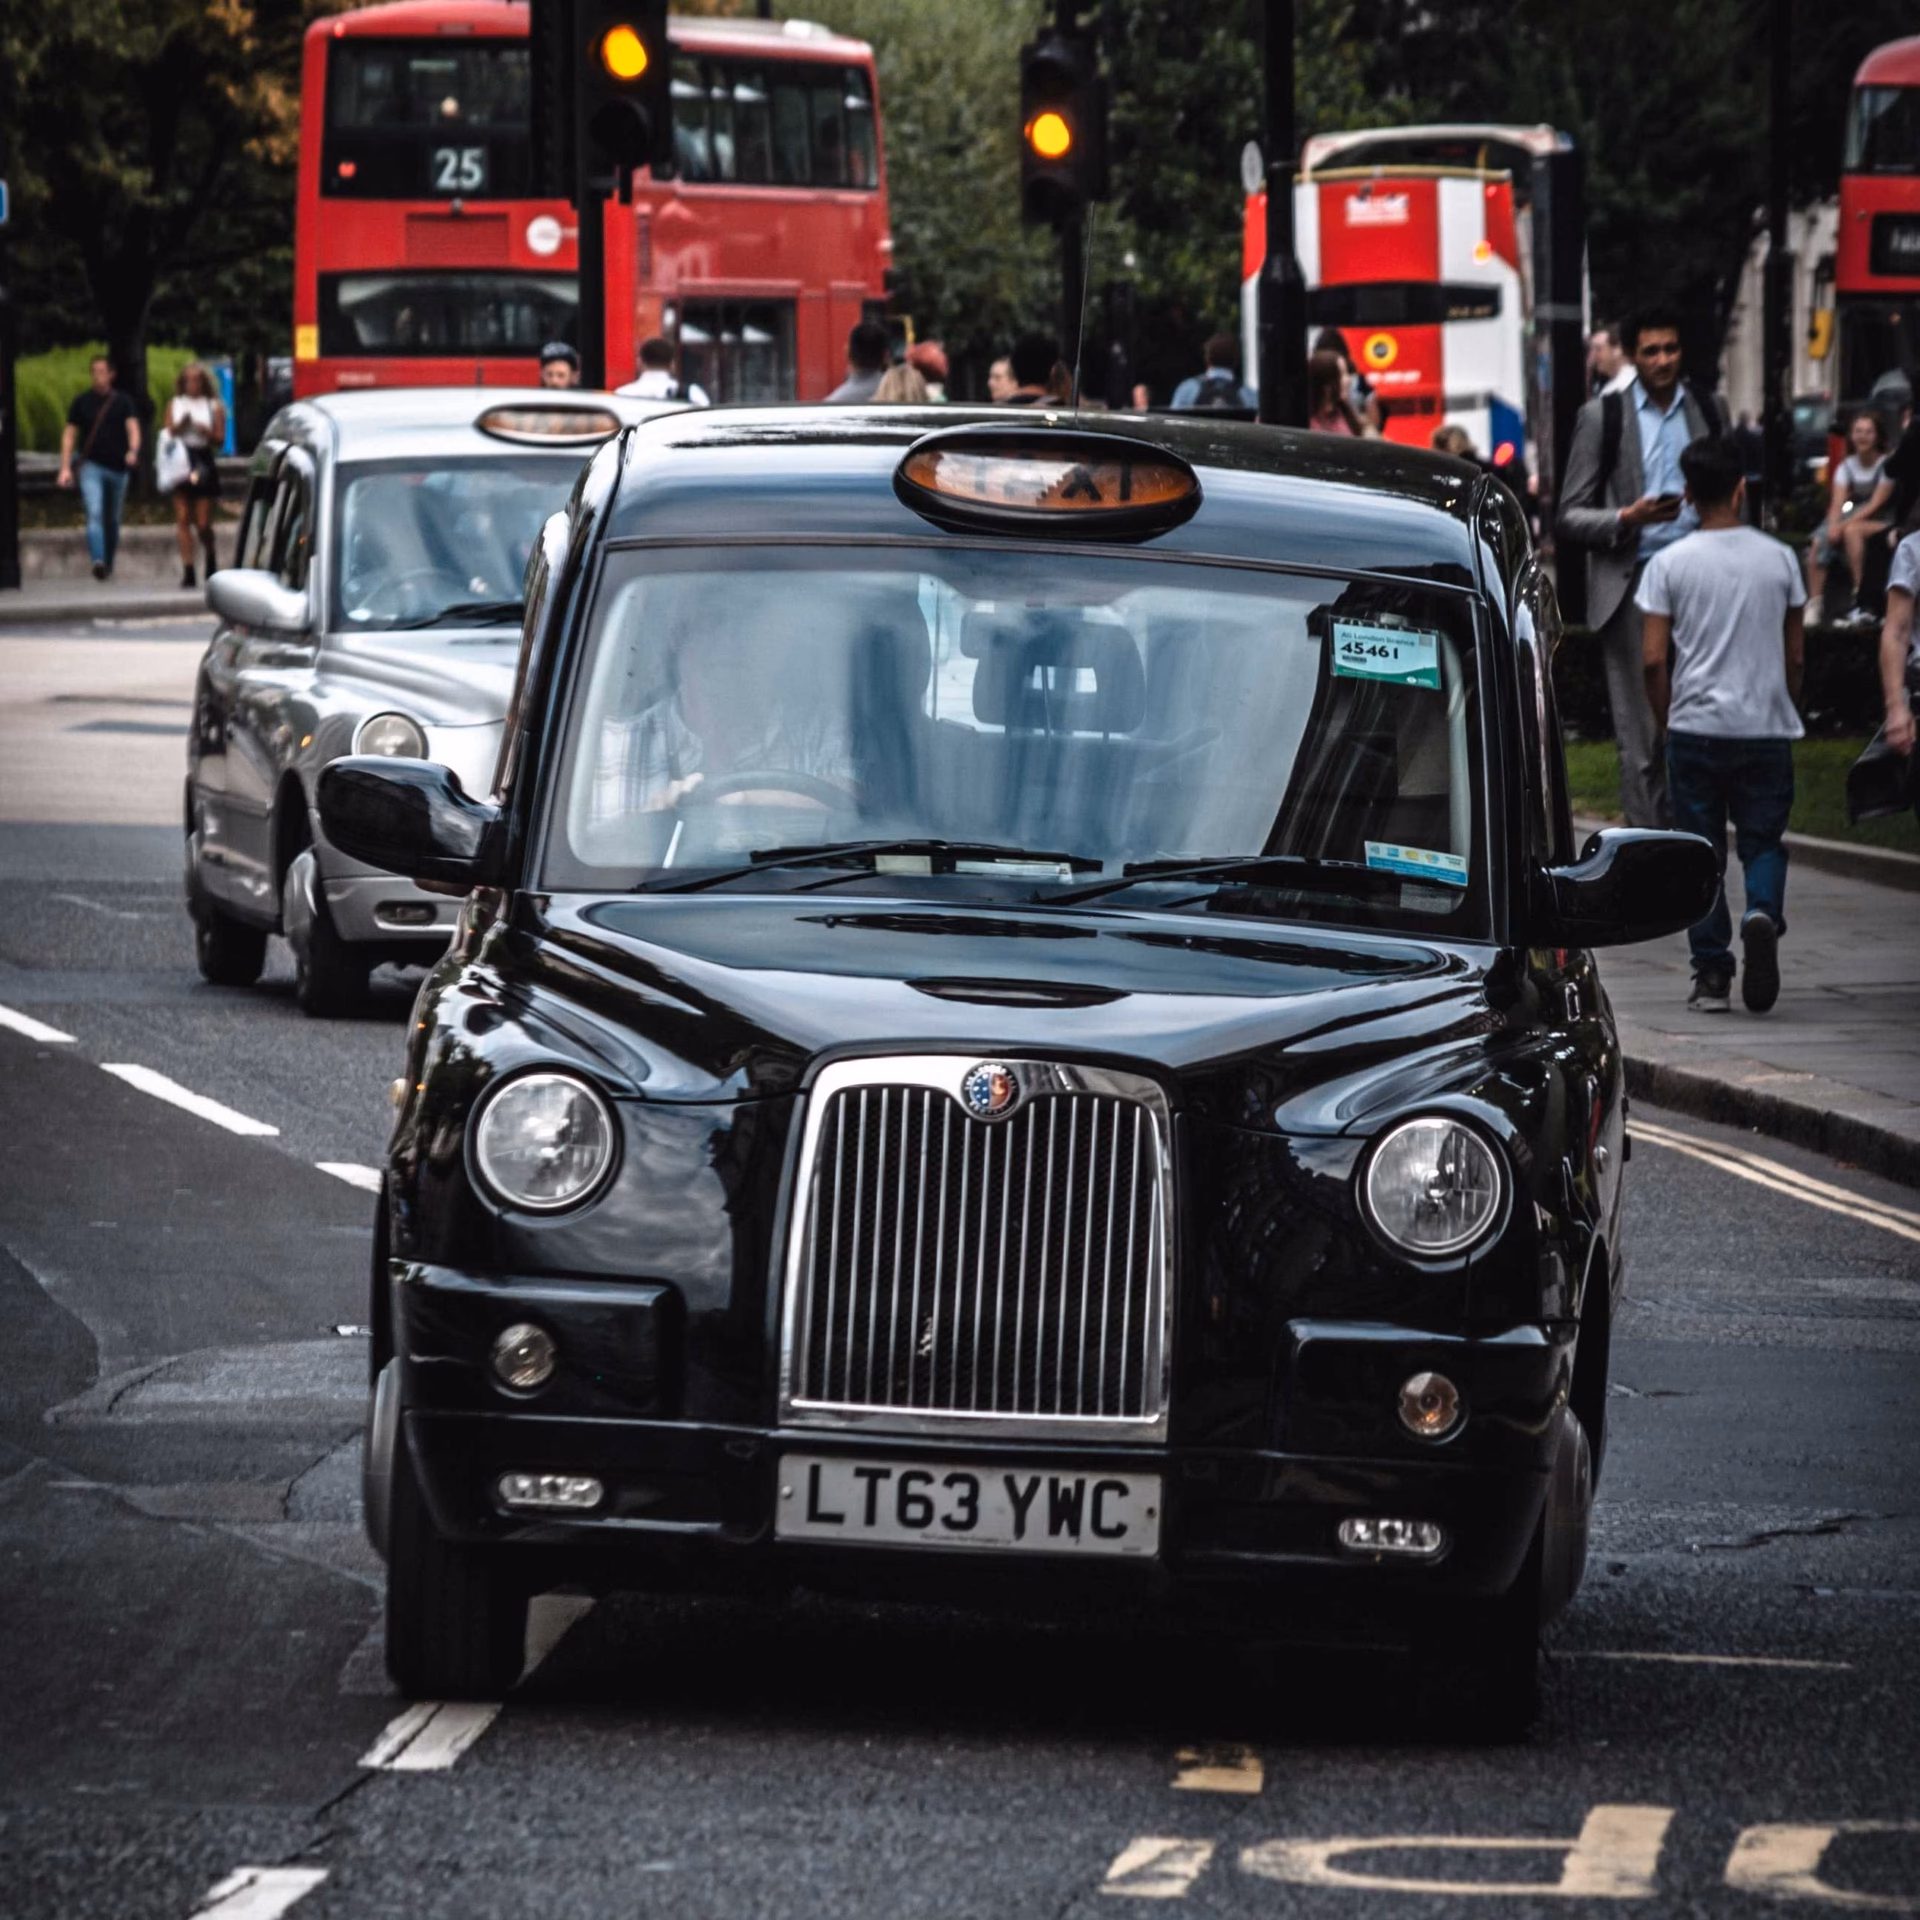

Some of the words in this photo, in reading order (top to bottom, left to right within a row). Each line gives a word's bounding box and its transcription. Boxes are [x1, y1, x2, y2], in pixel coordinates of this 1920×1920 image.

[434, 147, 483, 190] 25
[1340, 642, 1399, 660] 45461
[1354, 633, 1385, 643] London
[806, 1463, 980, 1531] LT63
[1003, 1474, 1130, 1541] YWC
